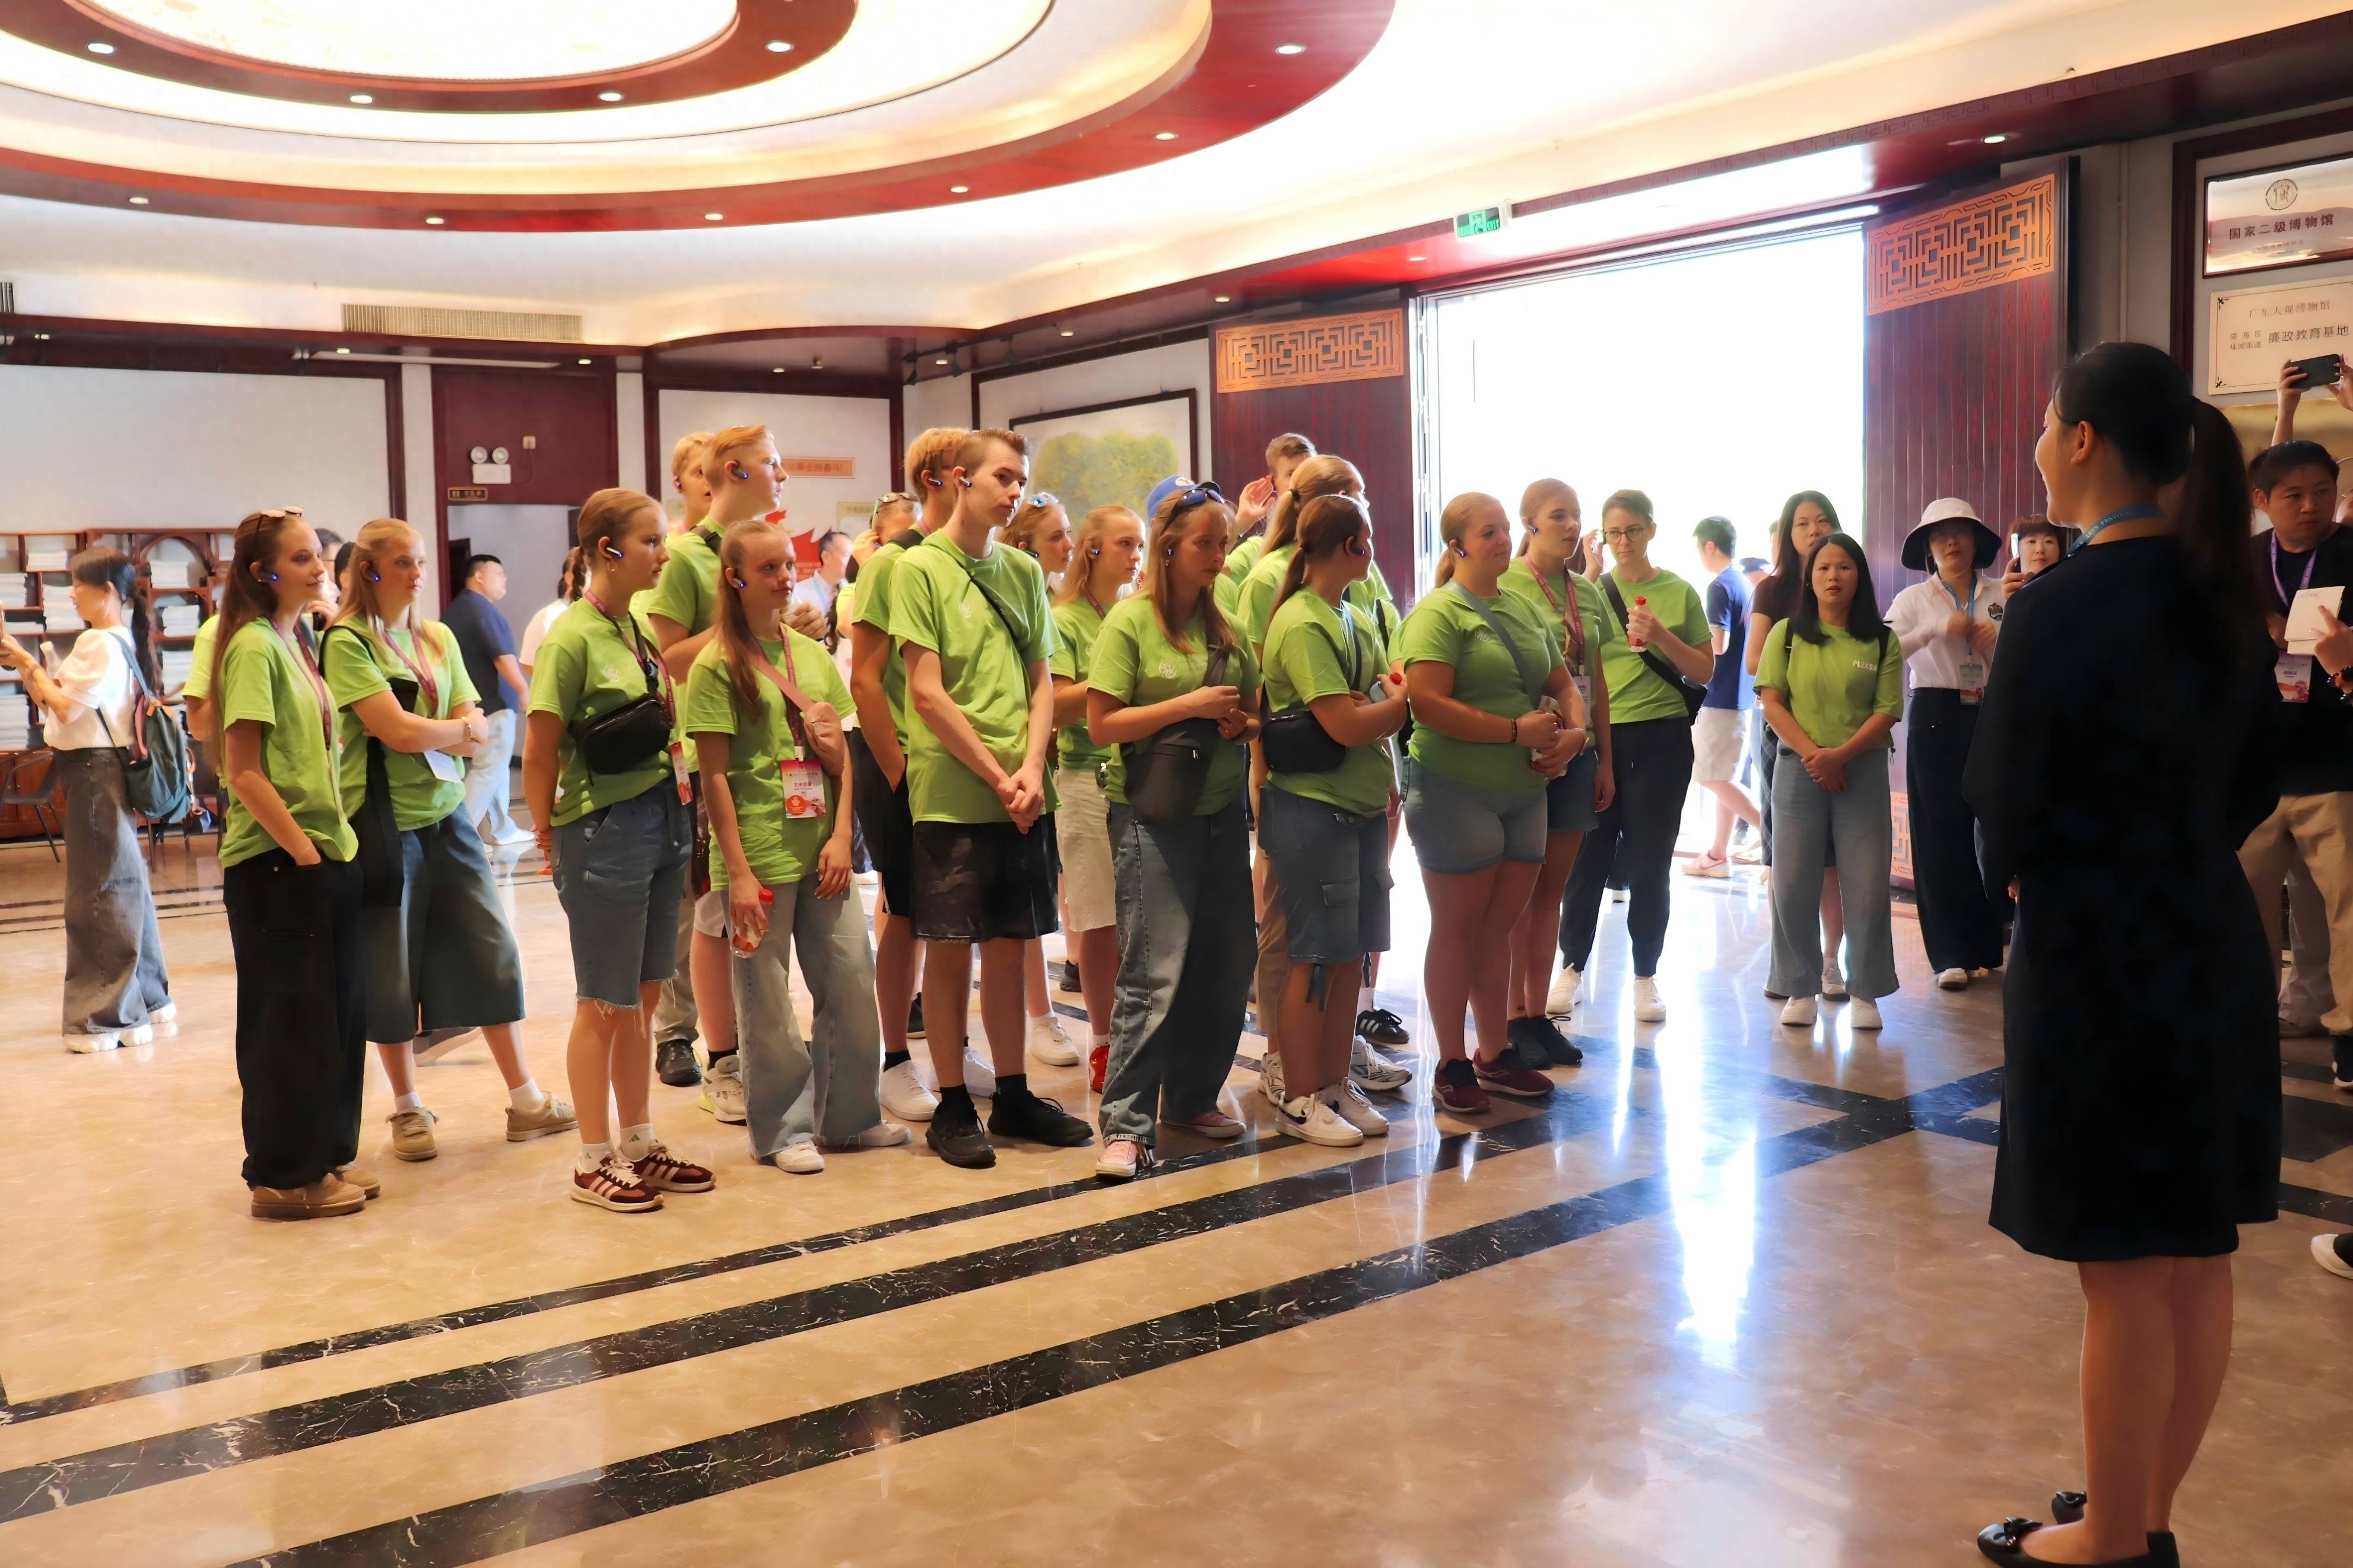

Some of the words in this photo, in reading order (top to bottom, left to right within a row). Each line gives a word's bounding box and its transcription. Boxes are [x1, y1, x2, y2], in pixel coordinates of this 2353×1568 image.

[2229, 214, 2334, 240] 国家二级博物馆
[2268, 324, 2349, 344] 廉政教育基地
